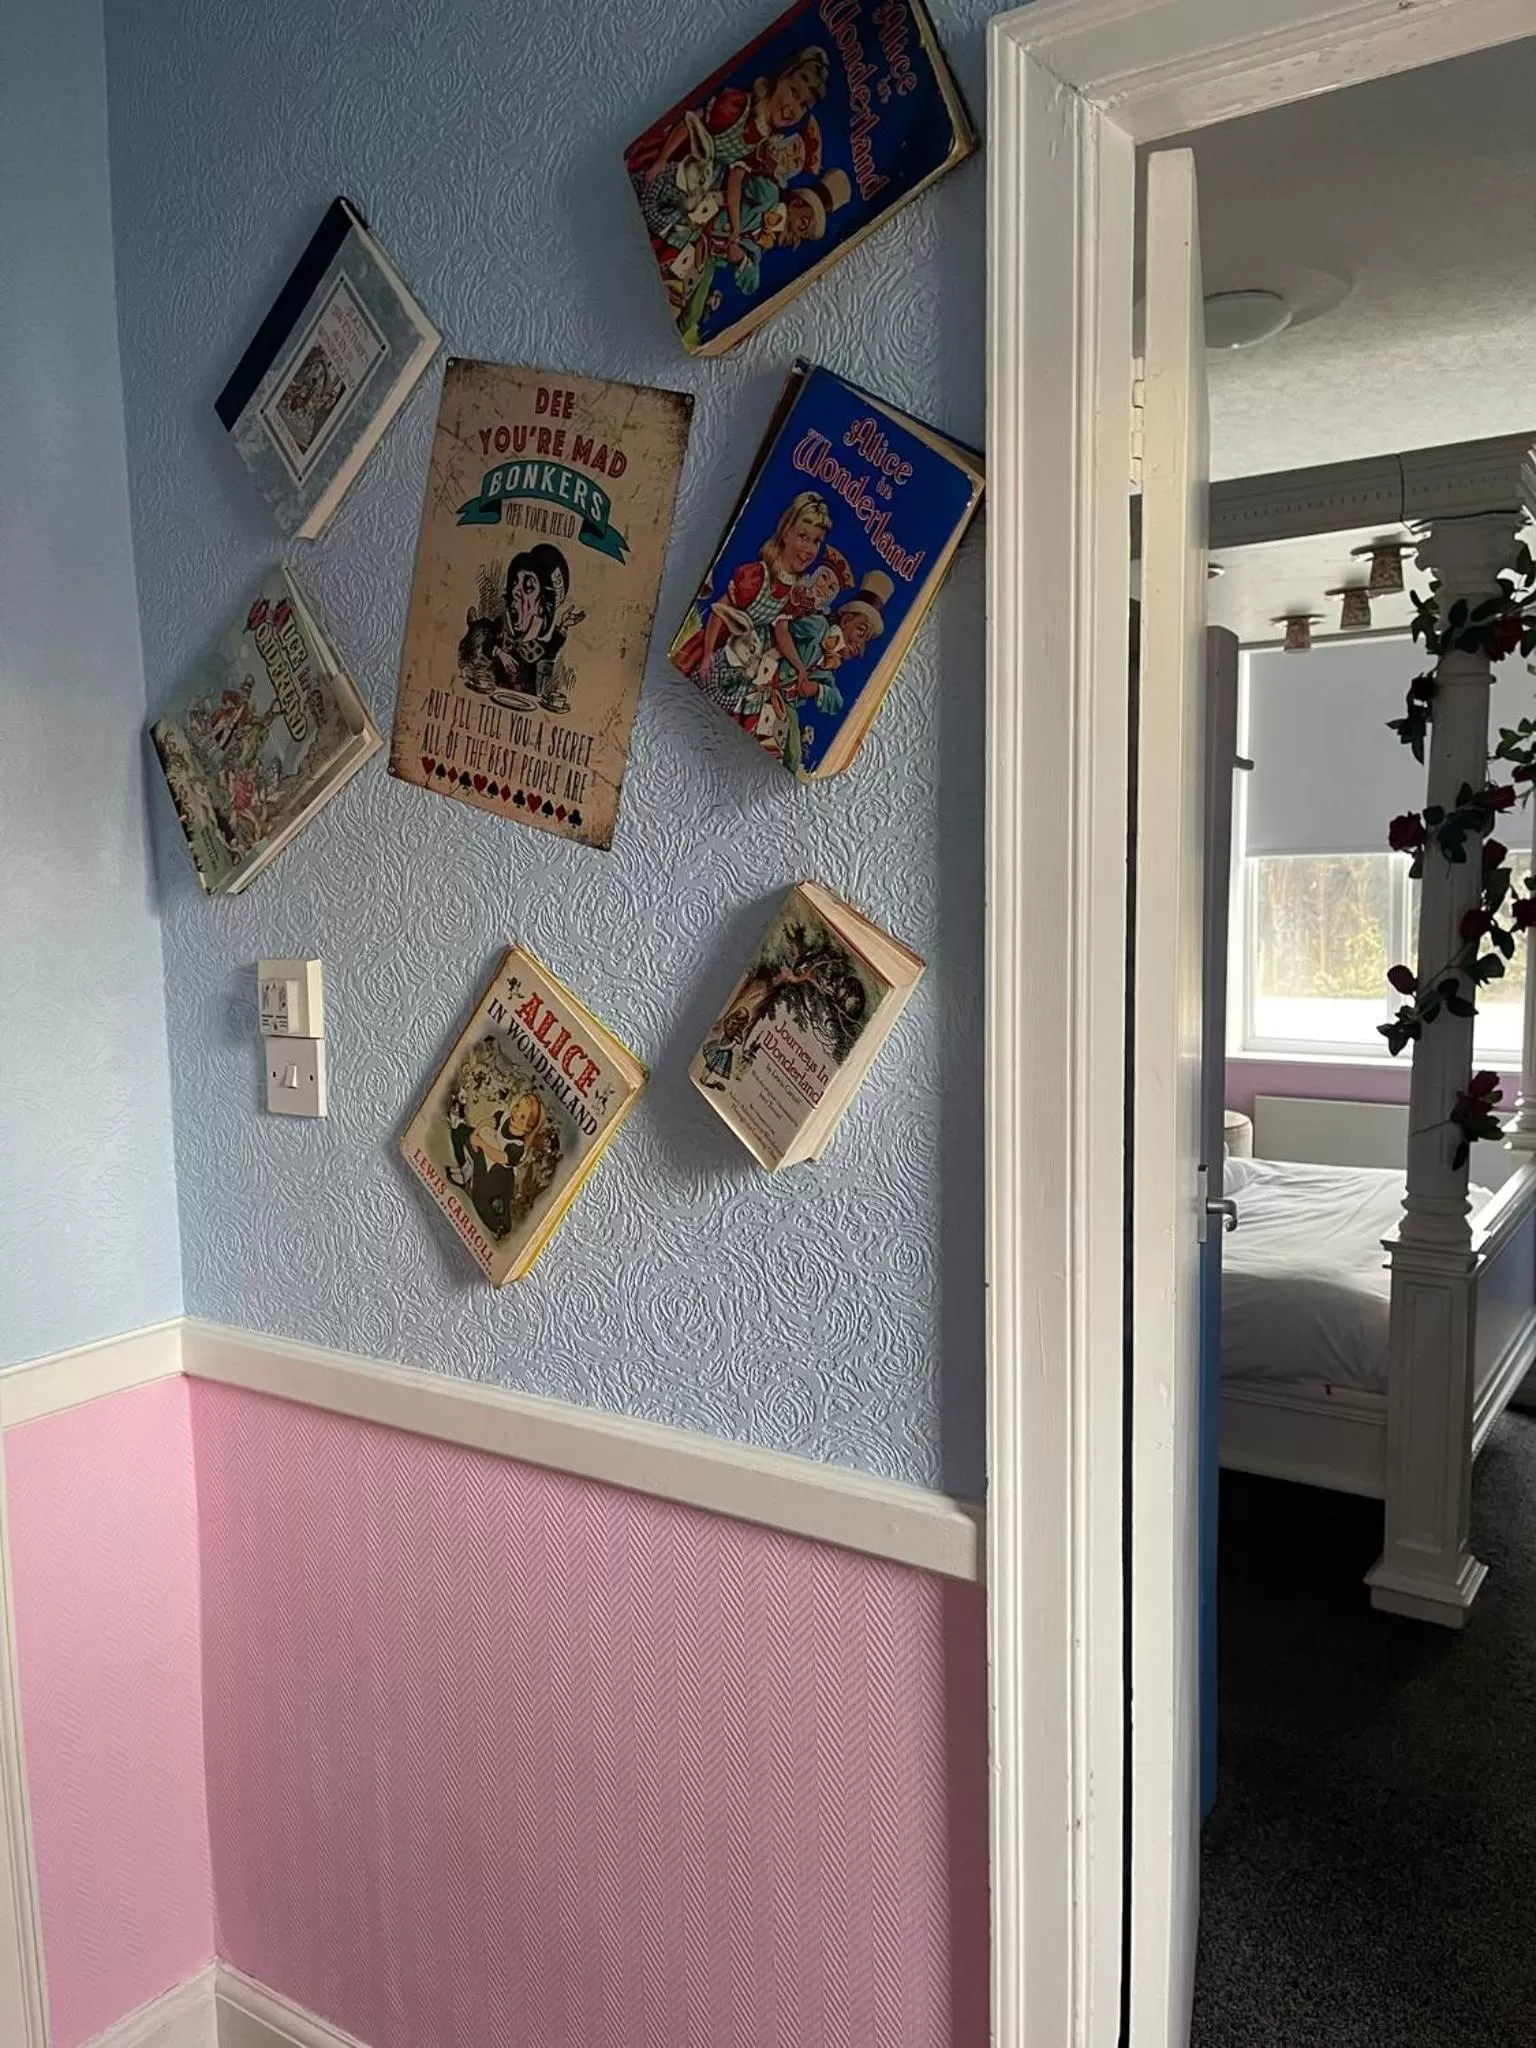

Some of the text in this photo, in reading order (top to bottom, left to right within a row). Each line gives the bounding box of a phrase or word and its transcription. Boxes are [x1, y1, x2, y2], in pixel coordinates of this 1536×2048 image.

[872, 0, 916, 96] Alice
[819, 0, 890, 201] Wonderland
[535, 387, 576, 419] DEE
[479, 425, 628, 479] YOU'RE MAD
[843, 417, 913, 485] Alice
[875, 476, 894, 500] in
[488, 463, 603, 522] BONKERS
[792, 428, 926, 582] Wonderland
[421, 723, 589, 804] ALL OF THE BEST PEOPLE ARE
[427, 688, 595, 768] BUT I'LL TELL YOU A SECRET
[486, 998, 599, 1137] IN WONDERLAND
[516, 991, 600, 1097] ALICE
[761, 1030, 825, 1105] Wonderland
[774, 1020, 818, 1075] Journeys
[817, 1065, 830, 1086] In
[412, 1147, 447, 1195] LEWIS
[446, 1195, 495, 1266] CARROLL
